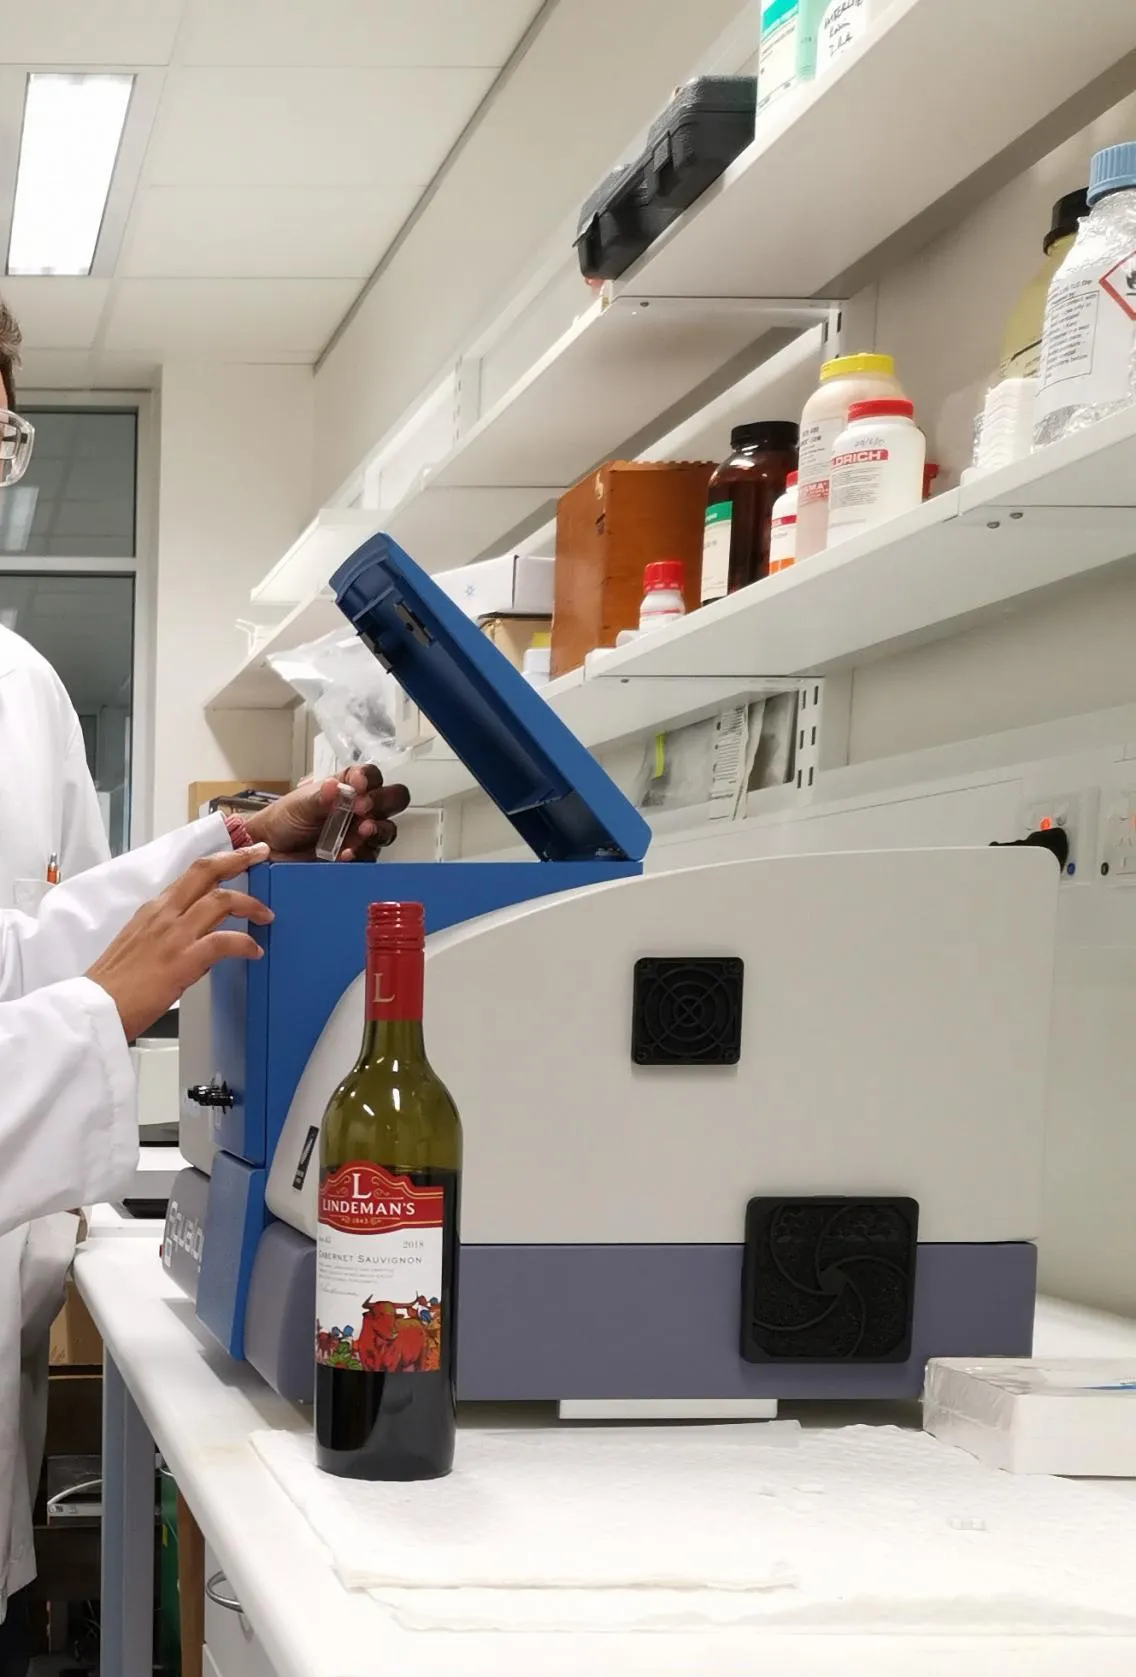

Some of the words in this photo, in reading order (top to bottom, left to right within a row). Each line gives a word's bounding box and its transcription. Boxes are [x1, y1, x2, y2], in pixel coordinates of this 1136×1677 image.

[373, 972, 396, 1003] L
[351, 1173, 372, 1199] L
[322, 1198, 416, 1216] LINDEMAN'S
[402, 1239, 424, 1250] 2018
[357, 1254, 423, 1265] SAUVIGNON
